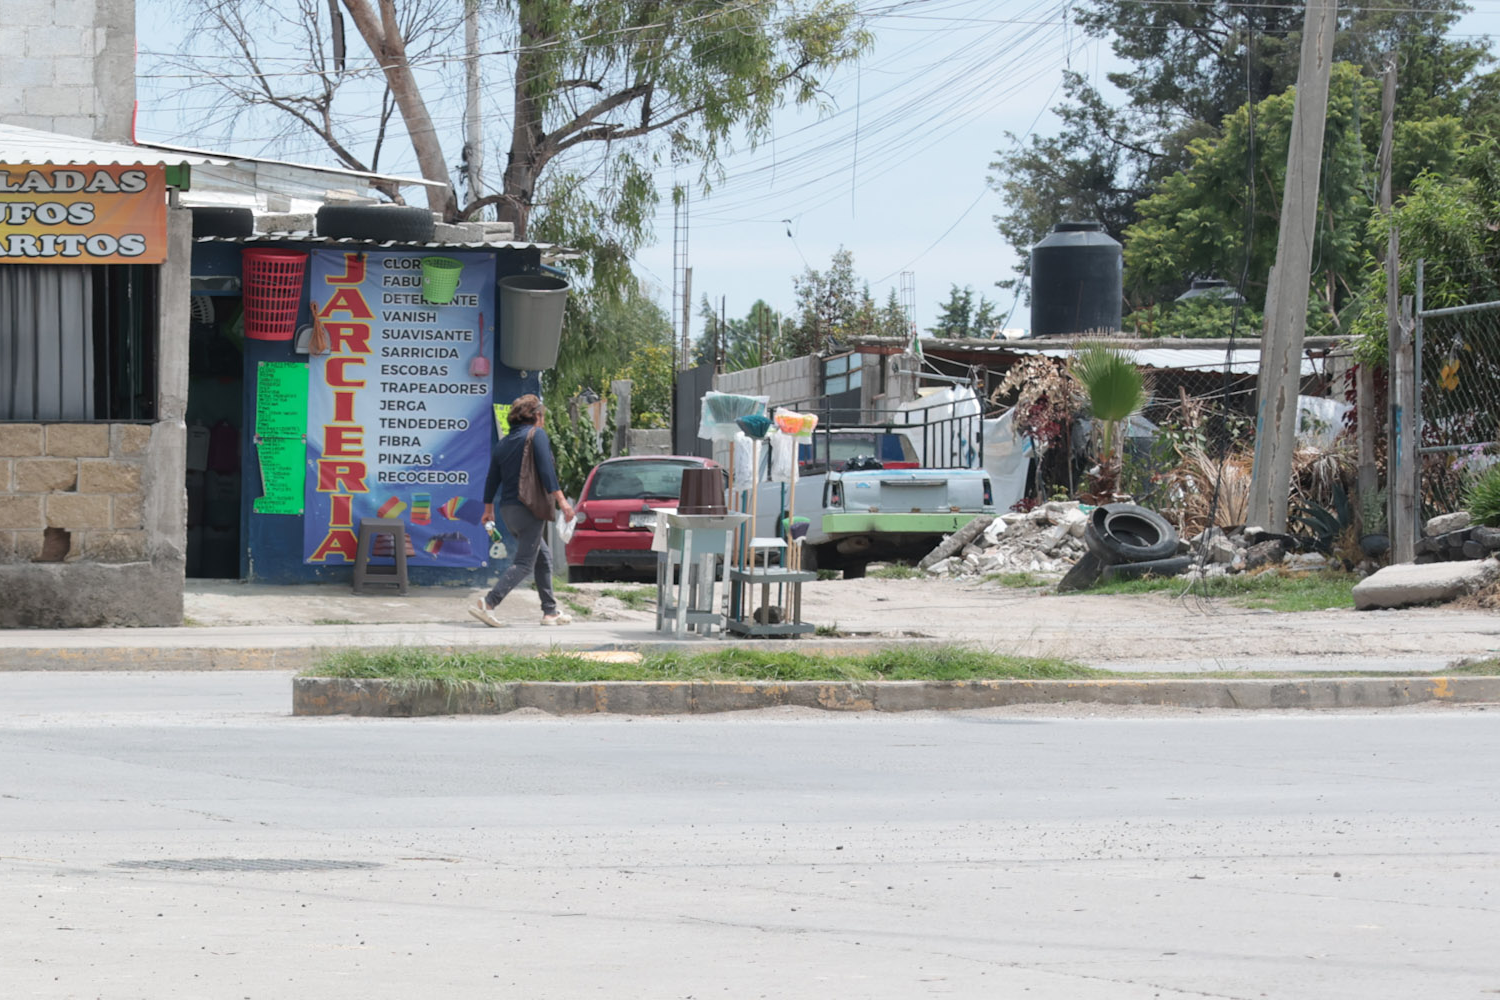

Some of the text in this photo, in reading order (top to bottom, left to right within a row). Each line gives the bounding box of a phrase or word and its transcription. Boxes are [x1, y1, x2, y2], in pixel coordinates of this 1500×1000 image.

[383, 259, 421, 270] CLOR
[382, 311, 436, 322] VANISH
[382, 329, 472, 341] SUAVISANTE
[381, 347, 459, 359] SARRICIDA
[381, 364, 448, 376] ESCOBAS
[380, 382, 487, 394] TRAPEADORES
[309, 252, 375, 563] JARCIERIA
[380, 400, 426, 411] JERGA
[379, 418, 468, 430] TENDEDERO
[379, 435, 421, 447] FIBRA
[378, 454, 431, 465] PINZAS
[378, 471, 467, 483] RECOGEDOR
